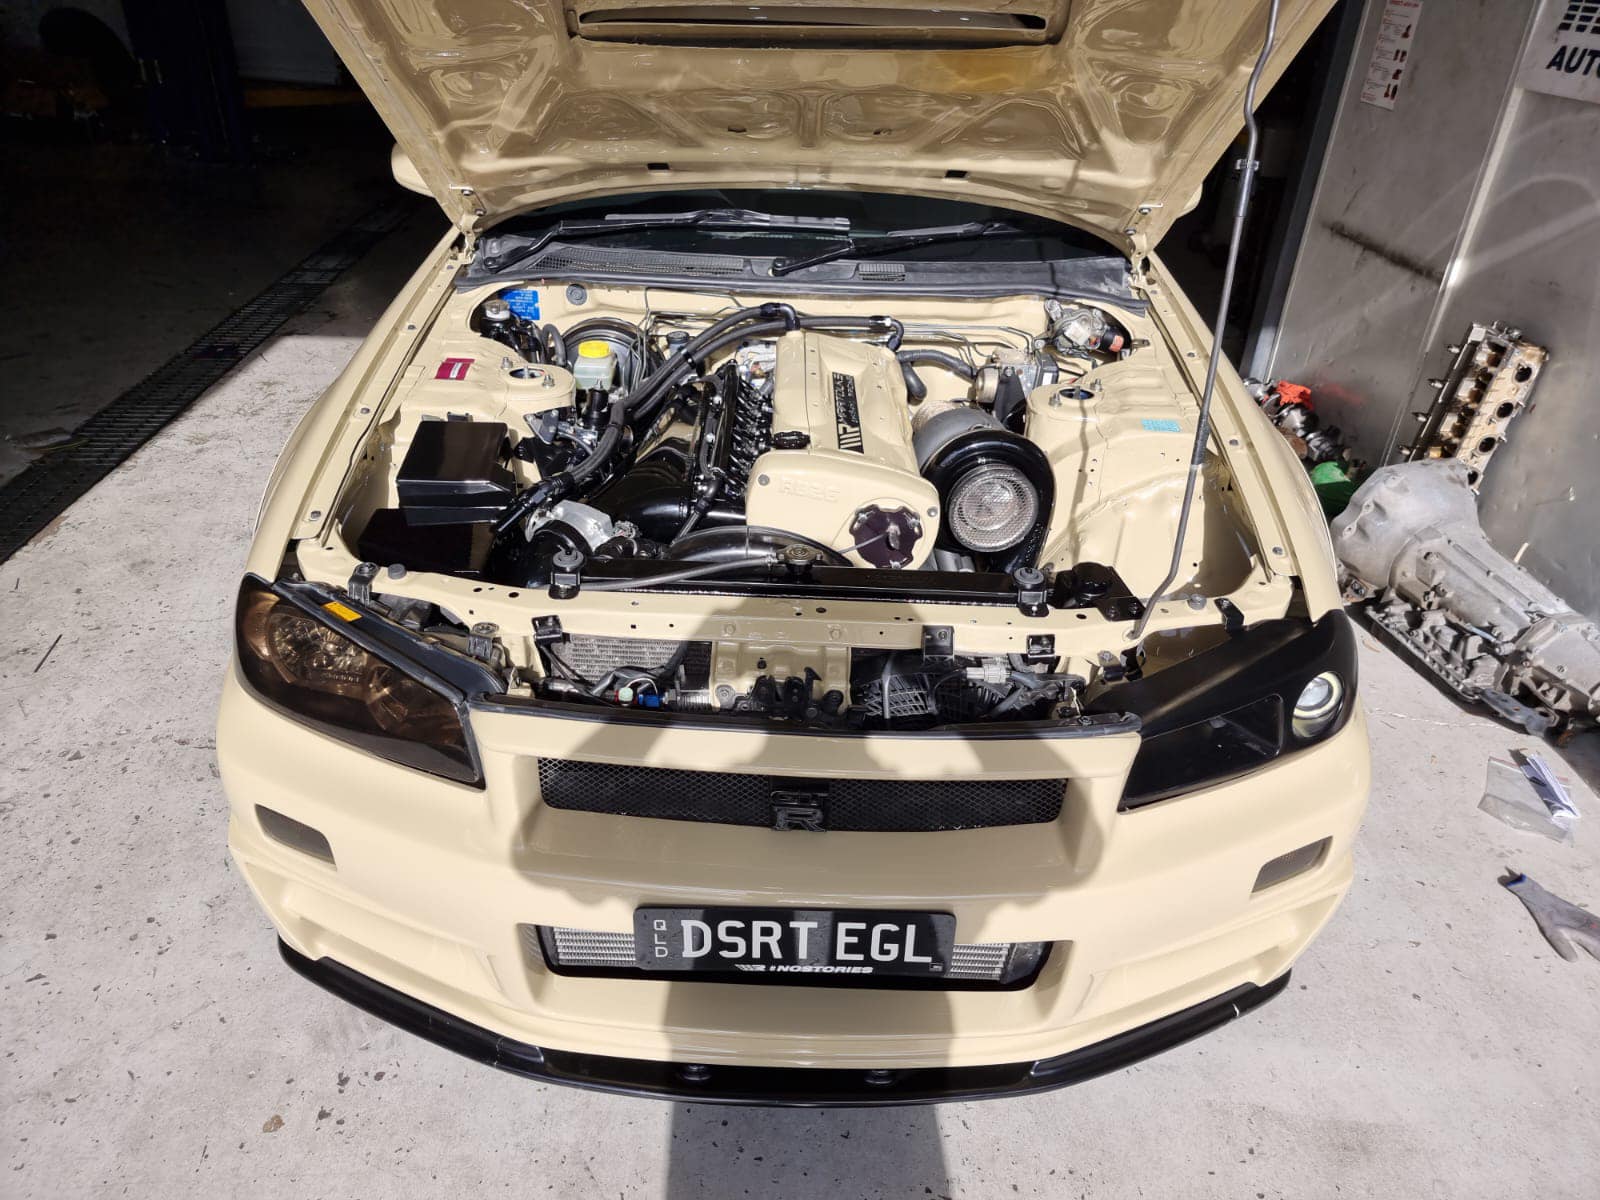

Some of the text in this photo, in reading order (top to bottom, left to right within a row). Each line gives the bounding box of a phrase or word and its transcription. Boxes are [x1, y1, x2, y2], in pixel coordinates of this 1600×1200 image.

[1545, 44, 1600, 78] AUT
[653, 919, 669, 958] QLD
[680, 919, 932, 963] DSRT EGL
